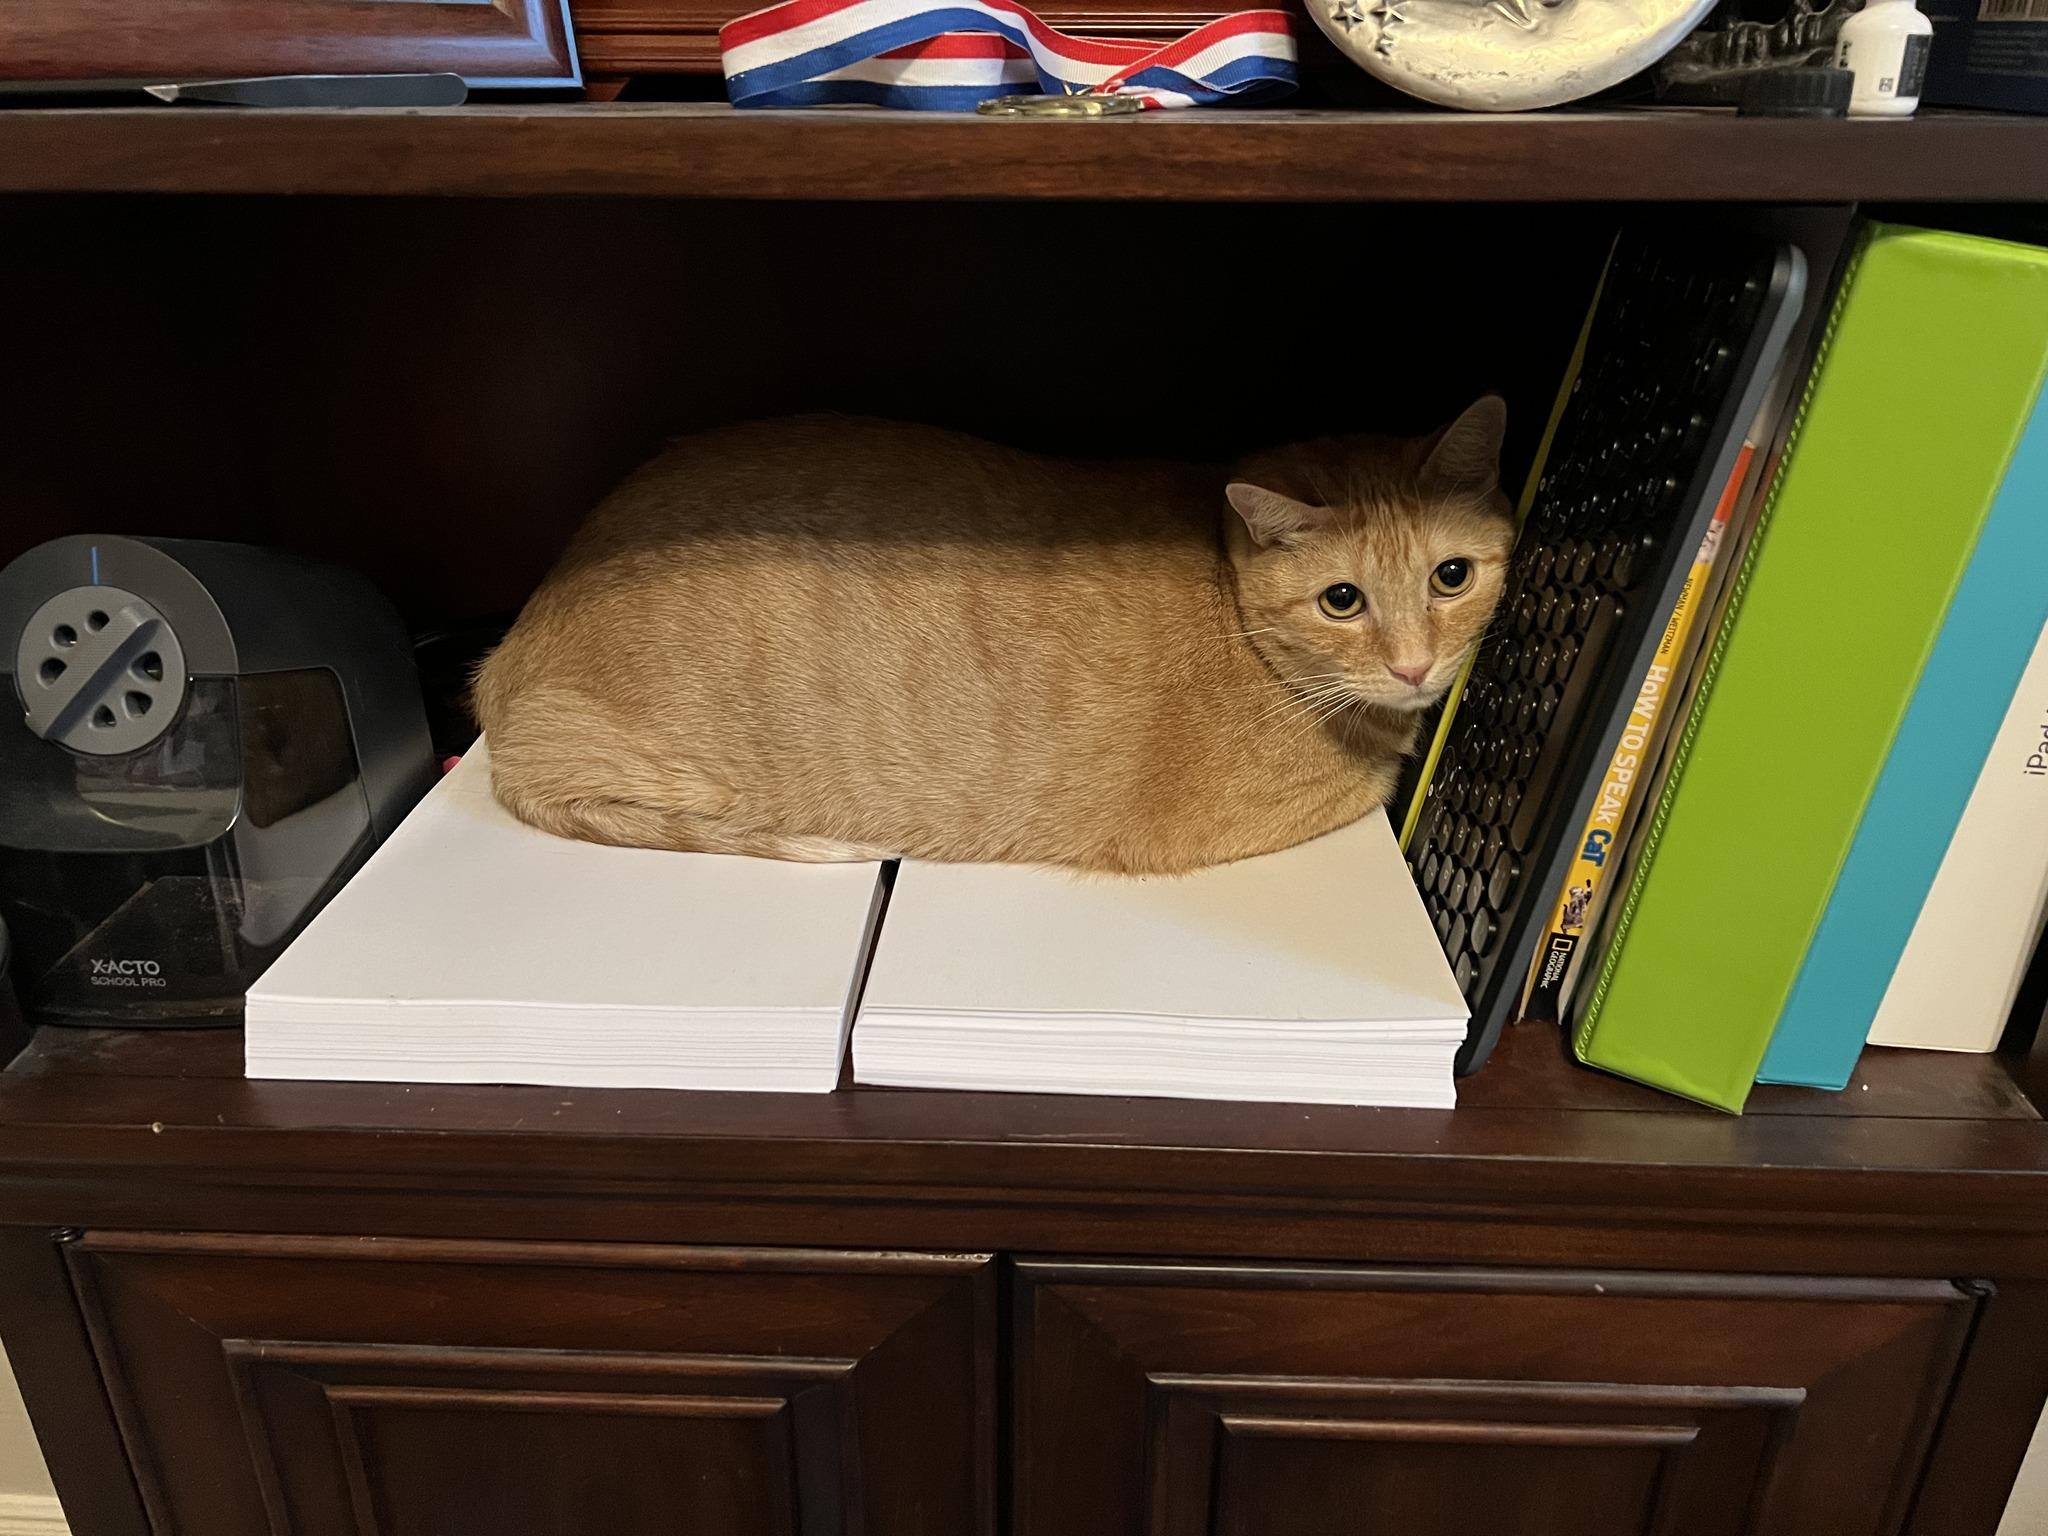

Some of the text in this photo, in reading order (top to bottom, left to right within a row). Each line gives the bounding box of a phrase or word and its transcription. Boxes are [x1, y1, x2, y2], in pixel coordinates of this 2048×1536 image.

[1661, 617, 1679, 655] WEITZMAN
[1621, 722, 1650, 751] TO
[91, 959, 160, 975] X-ACTO
[1540, 951, 1559, 989] GEOGRAPHIC
[1550, 952, 1567, 981] NATIONAL
[91, 976, 167, 987] SCHOOL PRO
